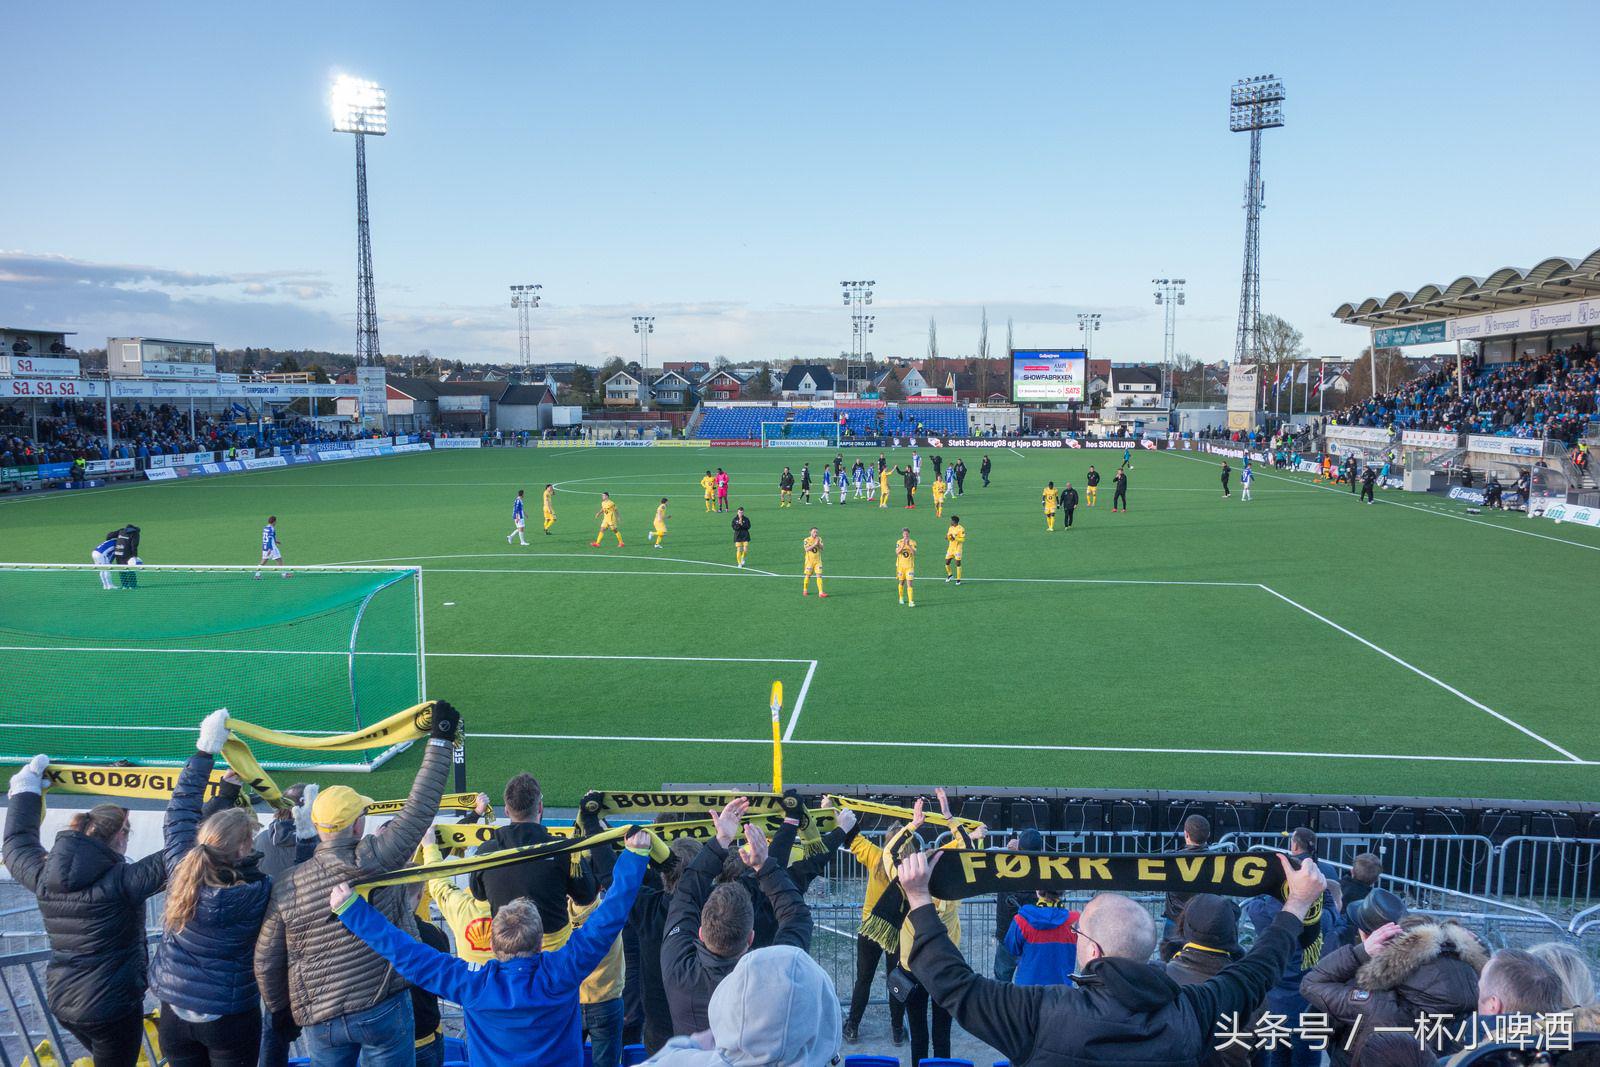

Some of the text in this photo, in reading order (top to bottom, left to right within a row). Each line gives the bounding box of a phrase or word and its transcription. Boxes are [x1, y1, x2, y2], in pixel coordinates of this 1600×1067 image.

[1494, 319, 1519, 332] Borregaard
[1540, 312, 1571, 326] Borregaard
[1065, 387, 1081, 395] SATS
[966, 440, 1006, 448] Sarpsborg08
[1017, 440, 1030, 448] kjøp
[611, 794, 689, 808] BODØ
[1138, 855, 1268, 887] EVIG
